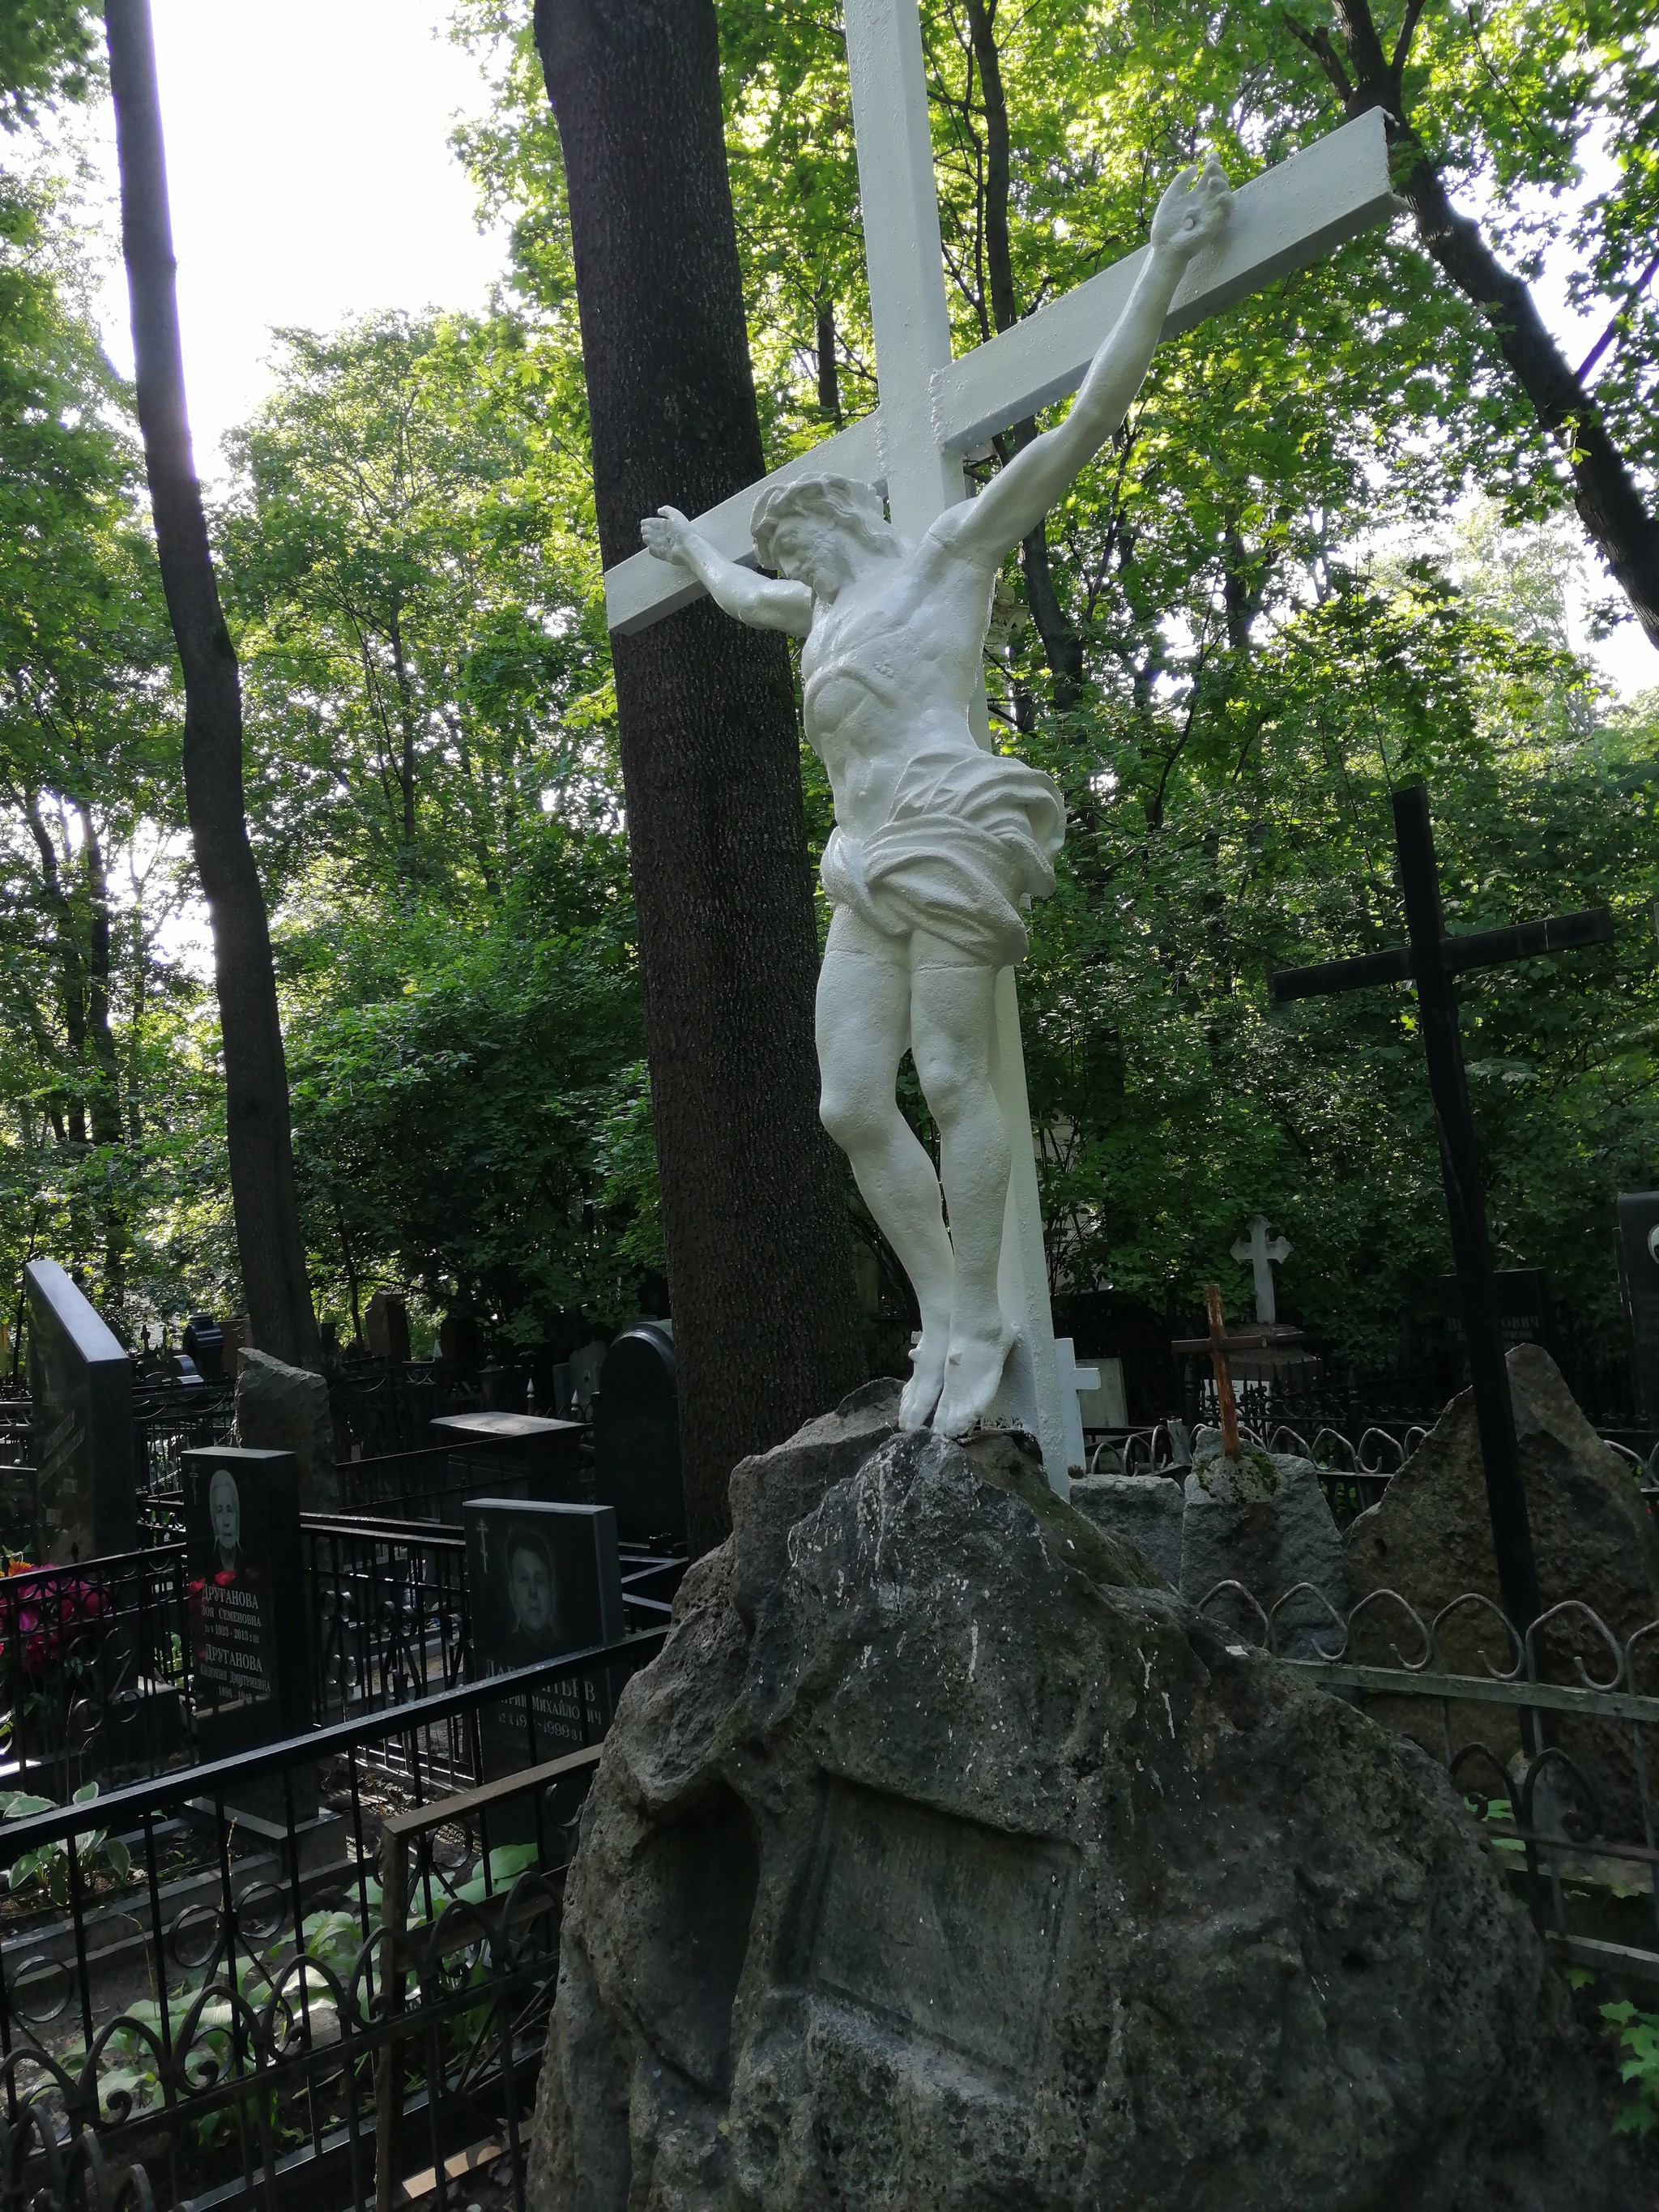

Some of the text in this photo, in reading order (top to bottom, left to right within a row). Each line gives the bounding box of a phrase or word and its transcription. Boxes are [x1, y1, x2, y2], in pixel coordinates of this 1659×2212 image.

[201, 1604, 262, 1628] ЗОЯ СЕМЕНОВНА
[233, 1628, 249, 1642] 2013
[229, 1671, 271, 1693] ДМИТРИЕВНА
[531, 1694, 603, 1725] МИХАЙЛОИЧ
[543, 1719, 570, 1738] 1999
